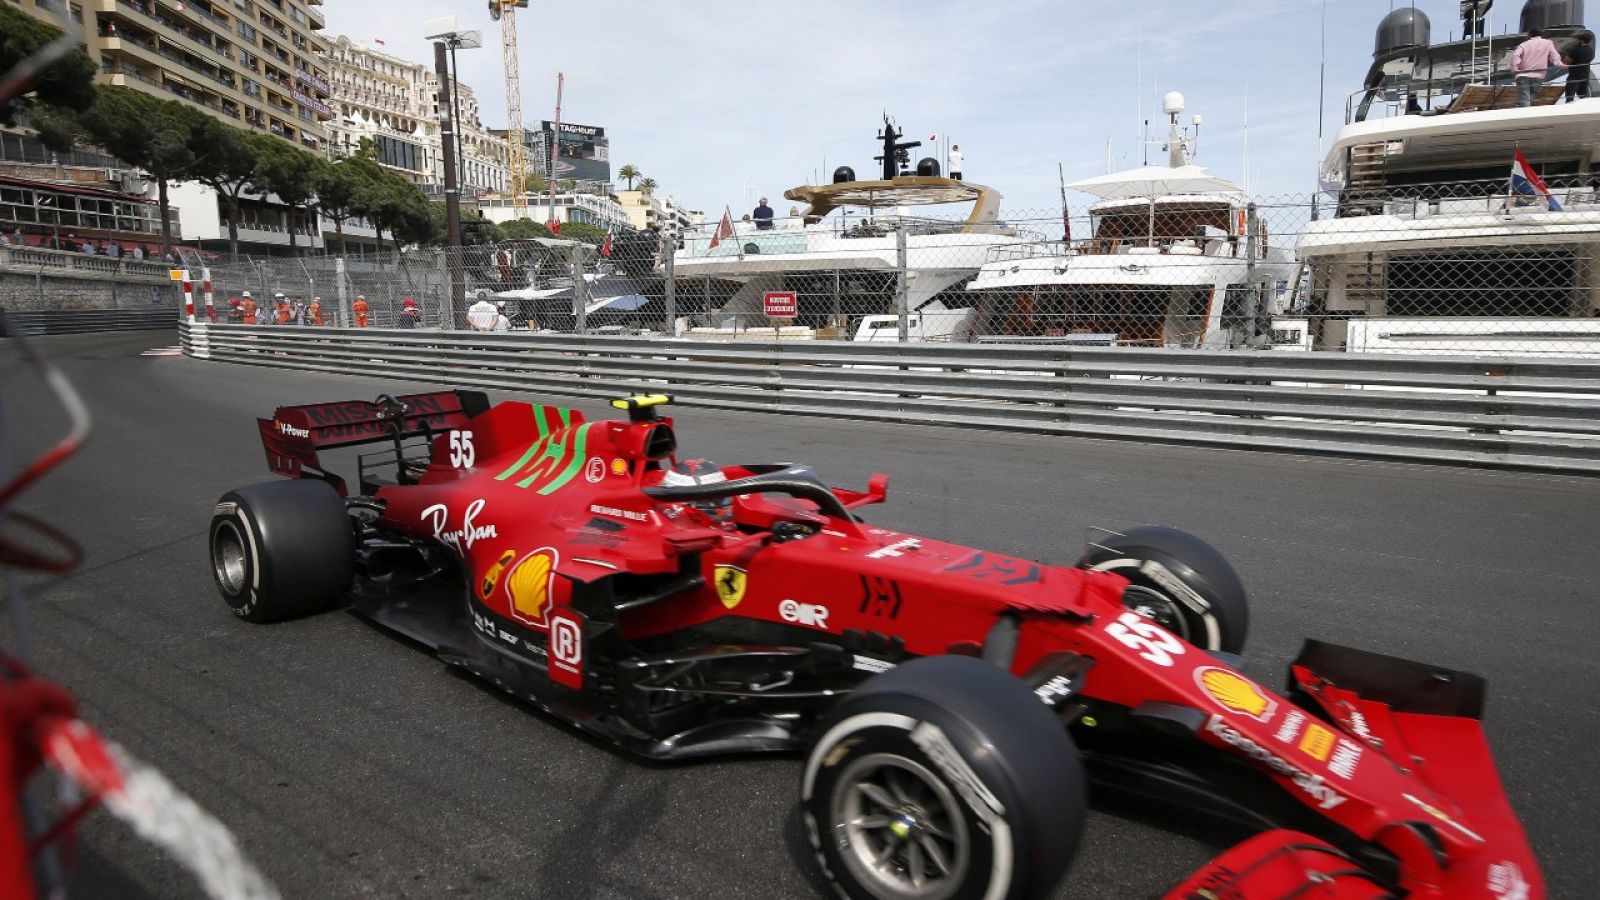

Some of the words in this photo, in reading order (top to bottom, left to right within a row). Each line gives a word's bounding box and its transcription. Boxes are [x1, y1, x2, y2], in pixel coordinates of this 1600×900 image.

[280, 422, 310, 439] V-Power
[450, 430, 475, 469] 55
[1104, 611, 1186, 667] 55
